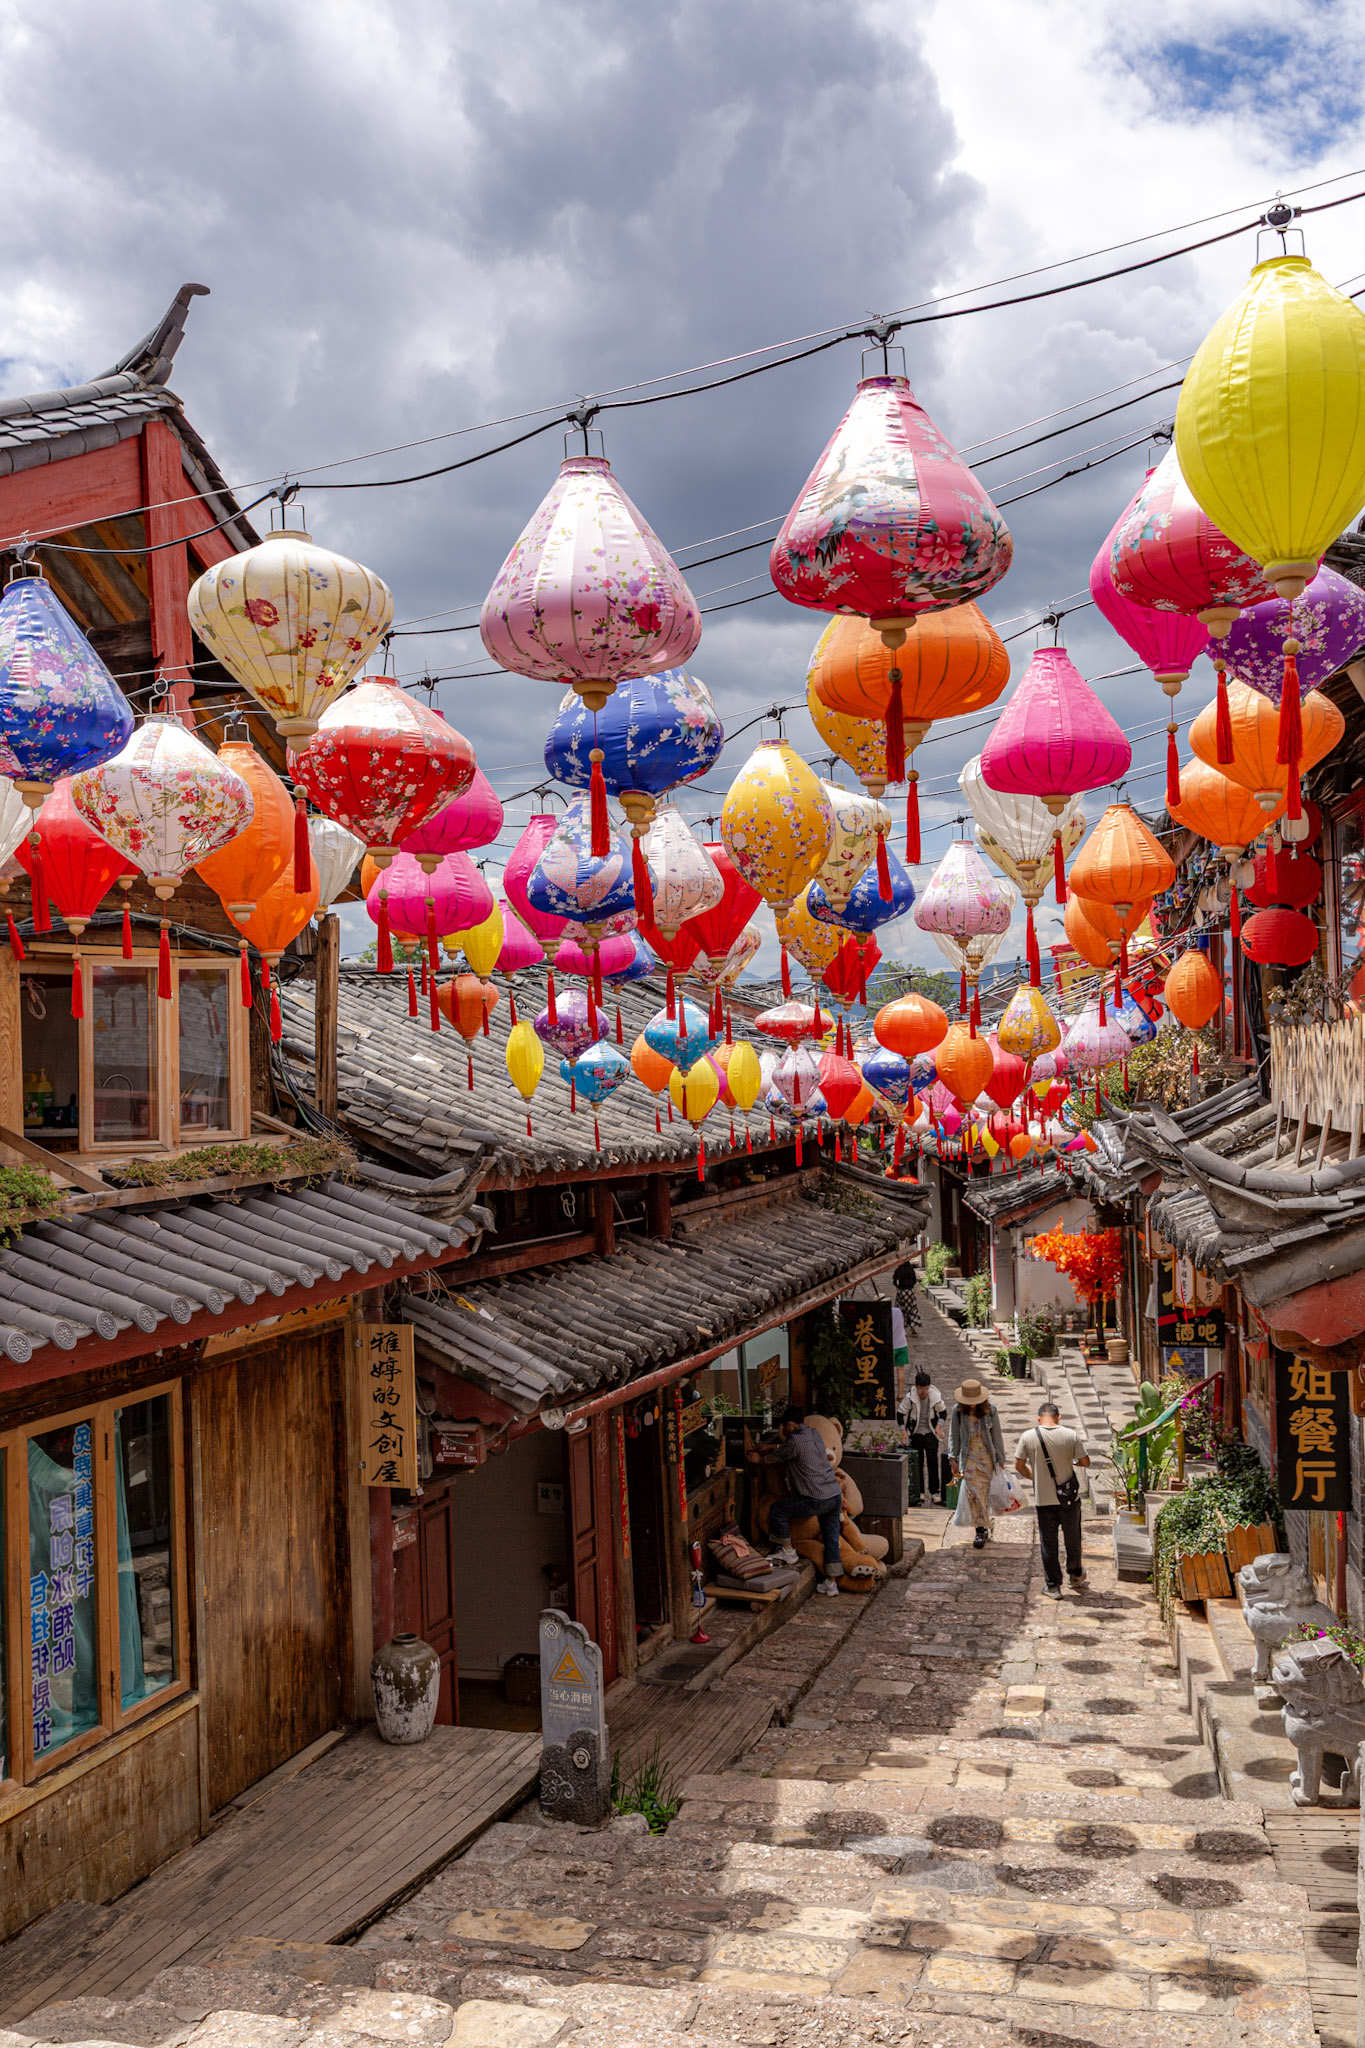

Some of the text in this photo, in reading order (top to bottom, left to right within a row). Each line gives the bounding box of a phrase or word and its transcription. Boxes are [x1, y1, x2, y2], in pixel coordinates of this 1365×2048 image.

[854, 1314, 885, 1385] 巷里
[1175, 1322, 1218, 1342] 酒吧
[369, 1331, 405, 1483] 雅婷的文创屋
[1288, 1358, 1338, 1503] 姐餐厅
[549, 1688, 592, 1705] 当心滑倒
